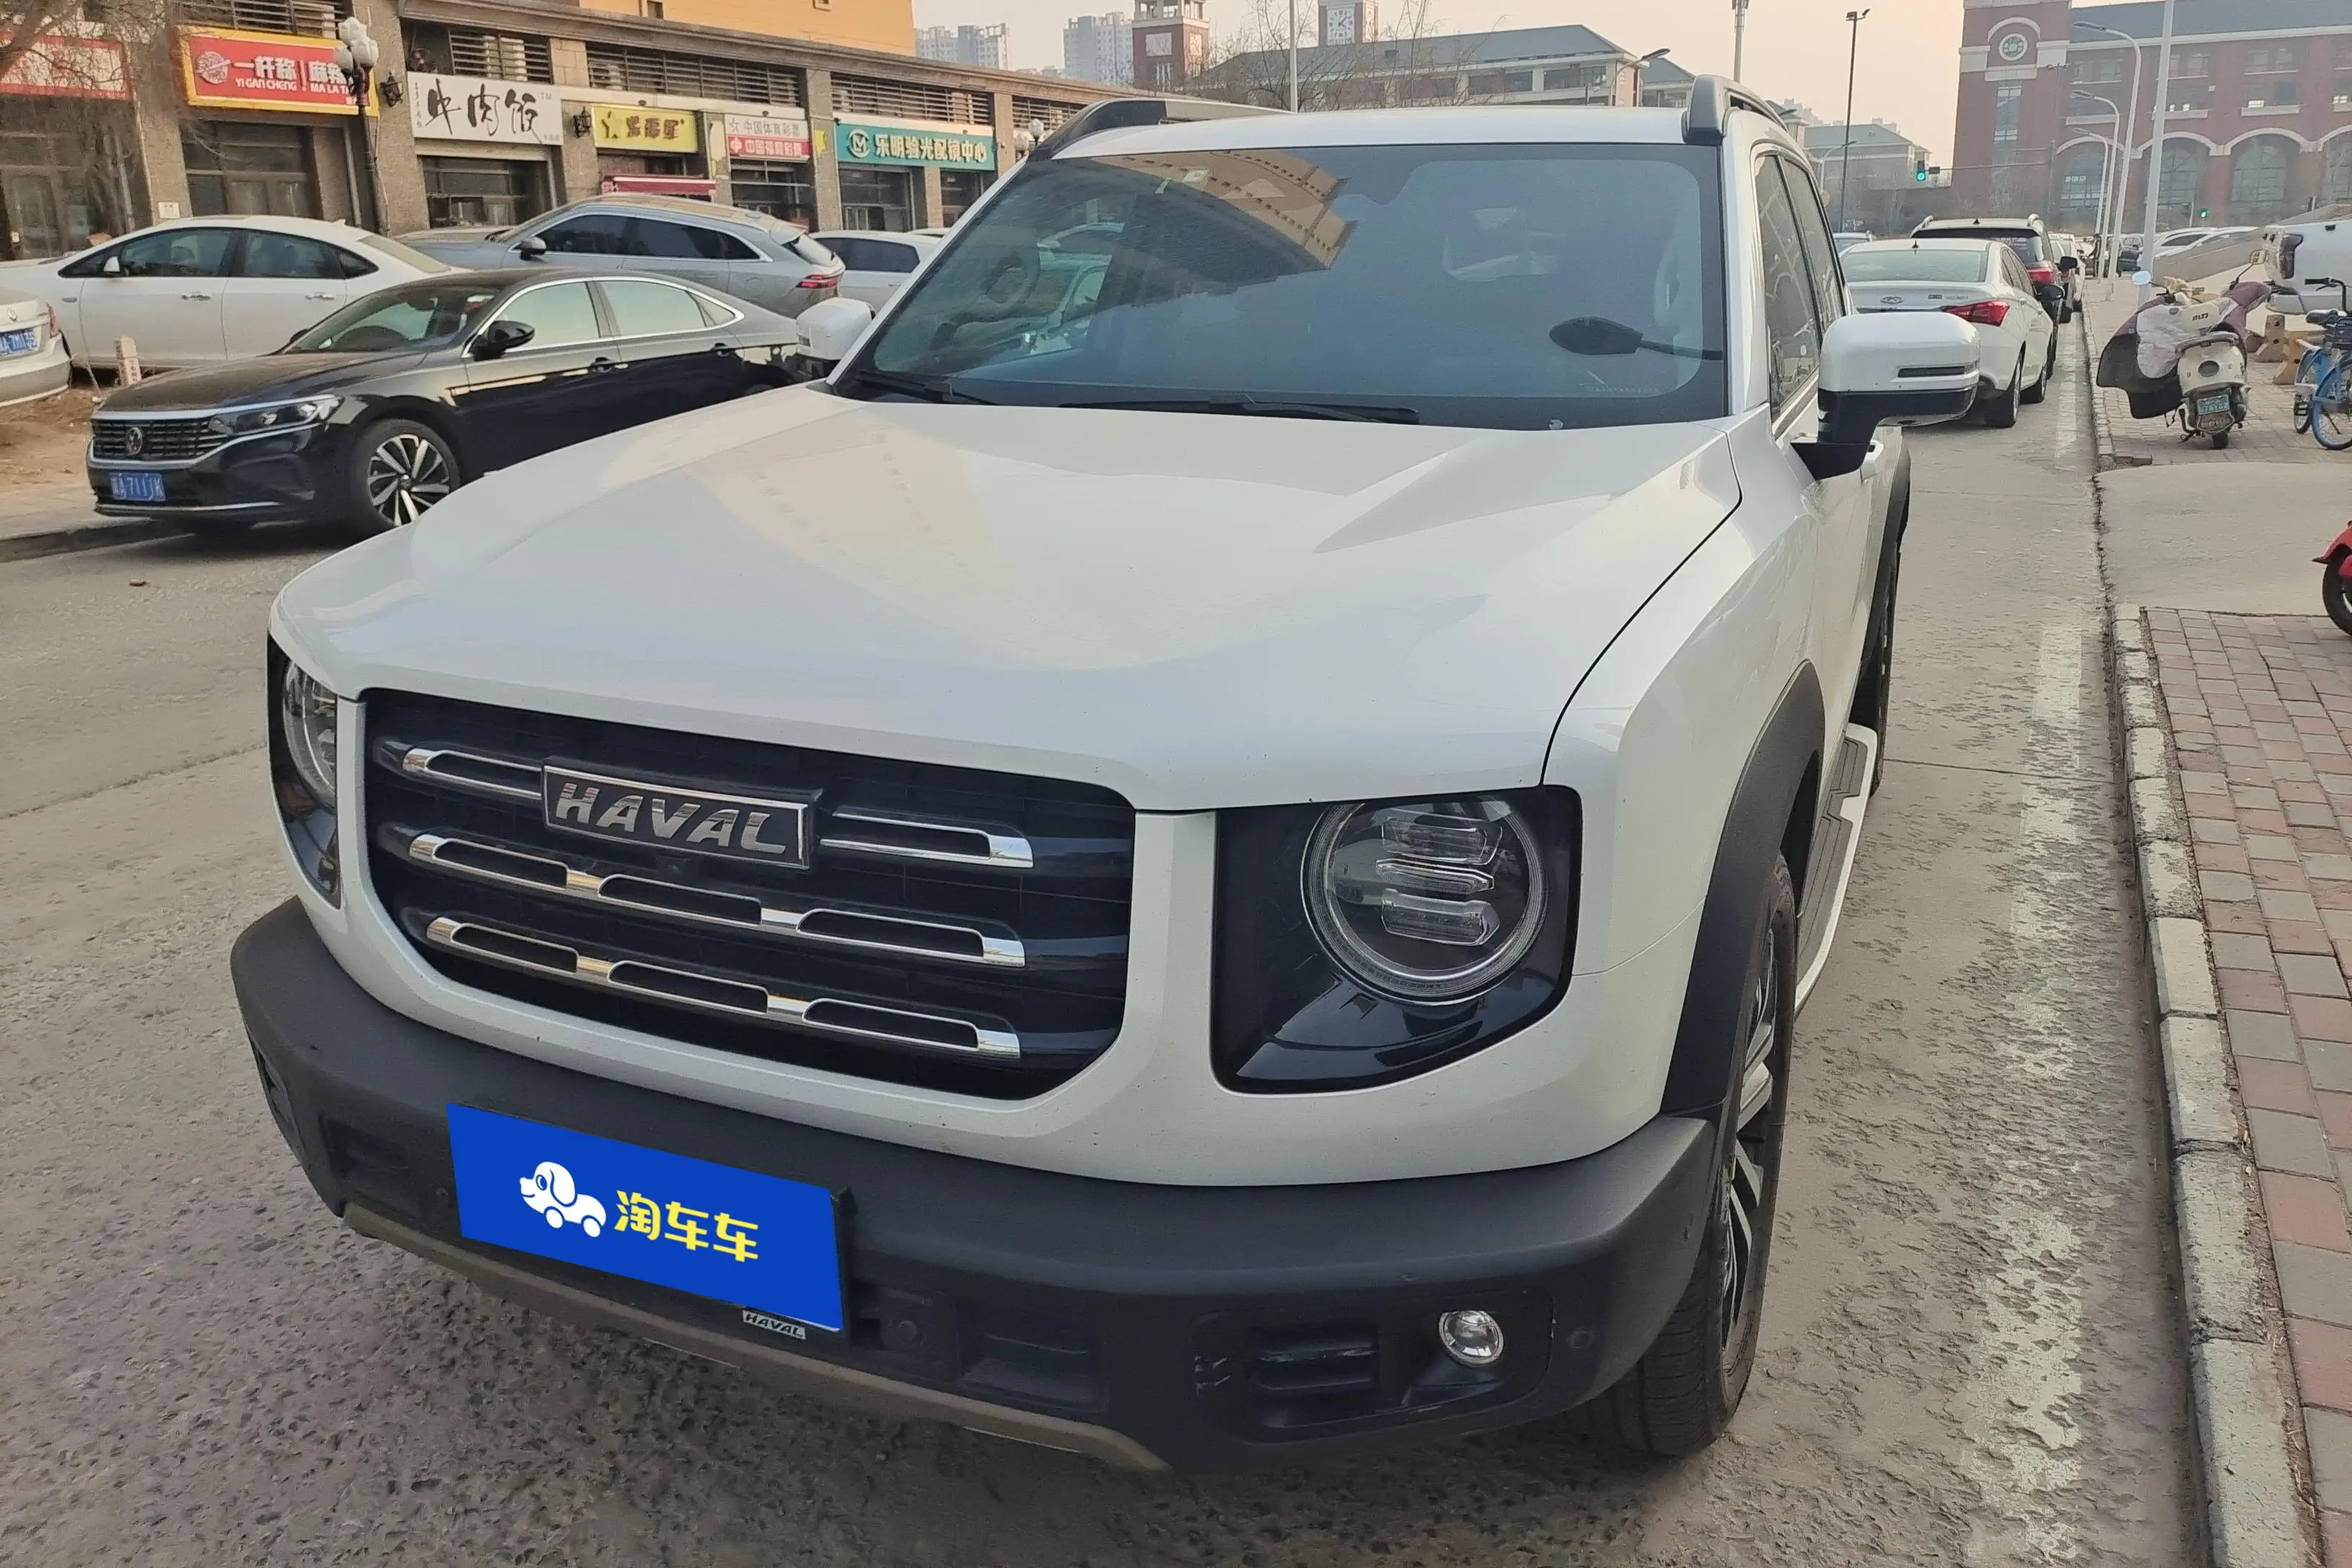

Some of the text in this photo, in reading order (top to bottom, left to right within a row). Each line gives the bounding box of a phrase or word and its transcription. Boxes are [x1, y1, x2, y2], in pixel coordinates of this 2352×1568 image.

[425, 78, 543, 144] 牛肉饭
[875, 134, 987, 163] 乐明验光配镜中心
[556, 782, 786, 855] HAVAL
[745, 1313, 803, 1338] HAVAL
